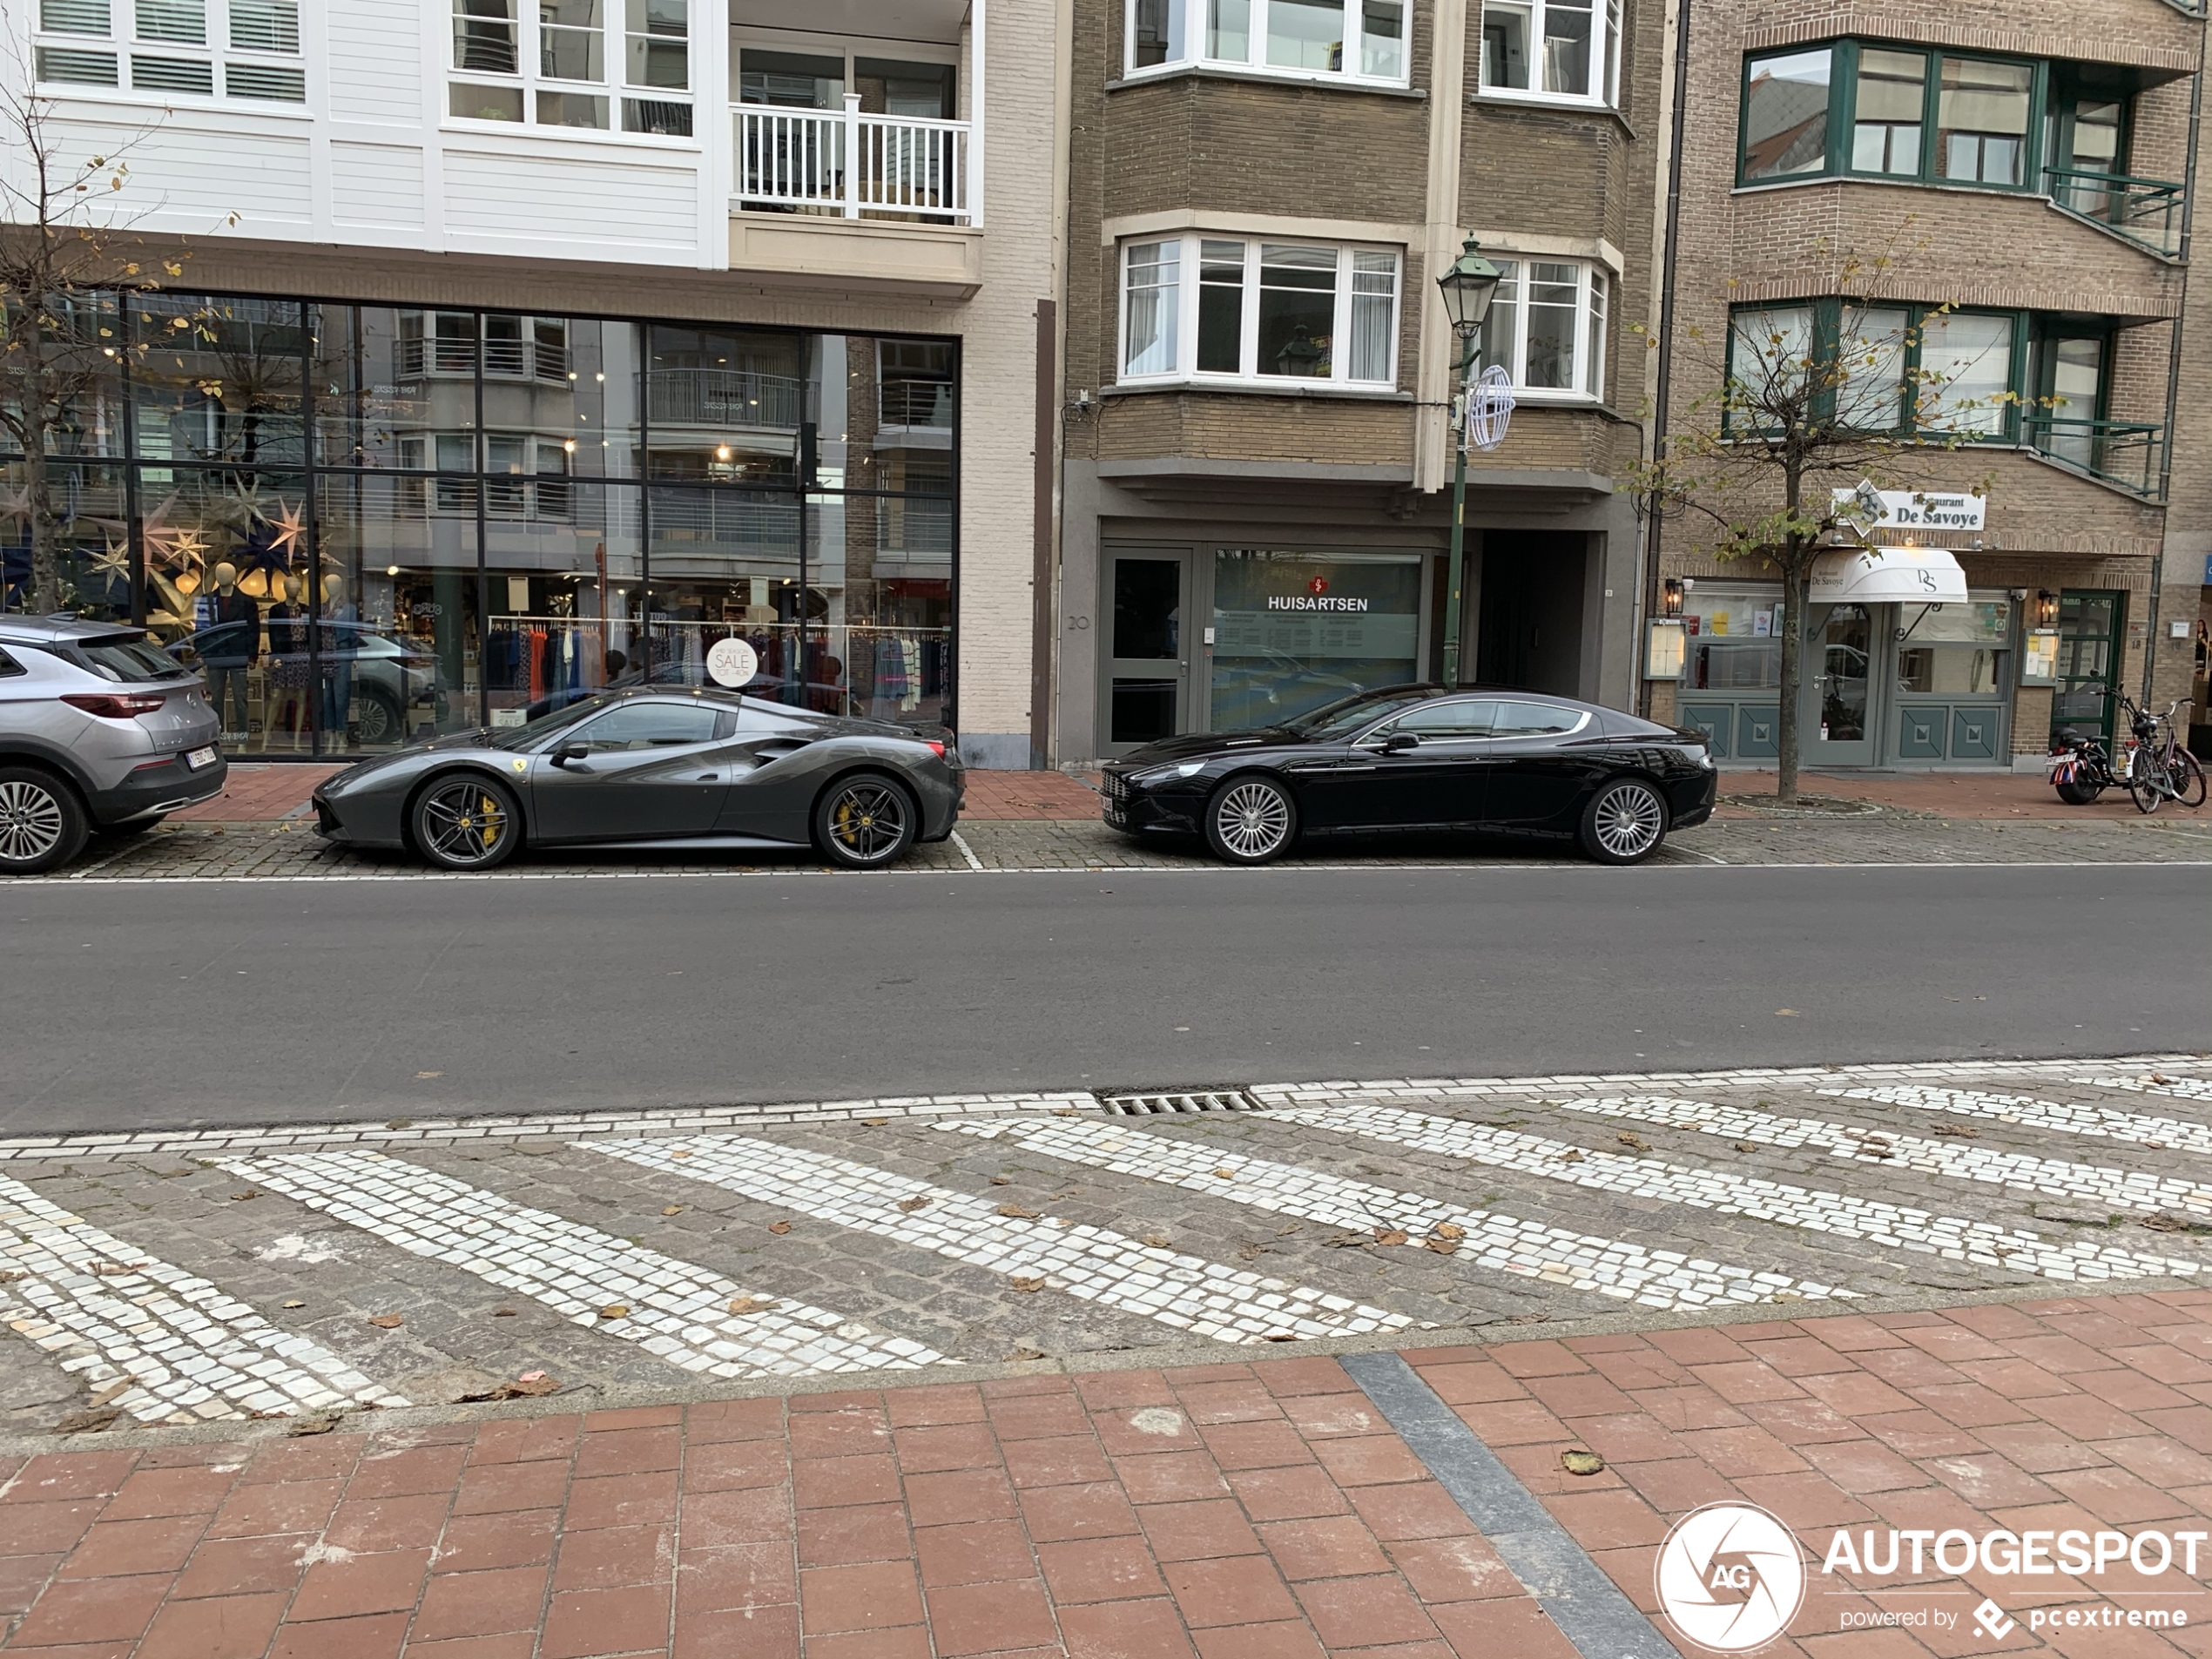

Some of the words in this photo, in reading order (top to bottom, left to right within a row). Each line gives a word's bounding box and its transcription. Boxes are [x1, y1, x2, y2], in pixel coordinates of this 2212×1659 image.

[374, 384, 417, 396] SISSY-BOY
[1912, 495, 1965, 508] esaurant
[1897, 508, 1919, 523] De
[1923, 509, 1979, 529] Savoye
[1811, 577, 1821, 585] De
[1822, 577, 1844, 587] Savoye
[1268, 597, 1368, 611] HUISARTSEN
[1068, 616, 1089, 631] 20
[715, 654, 749, 669] SALE
